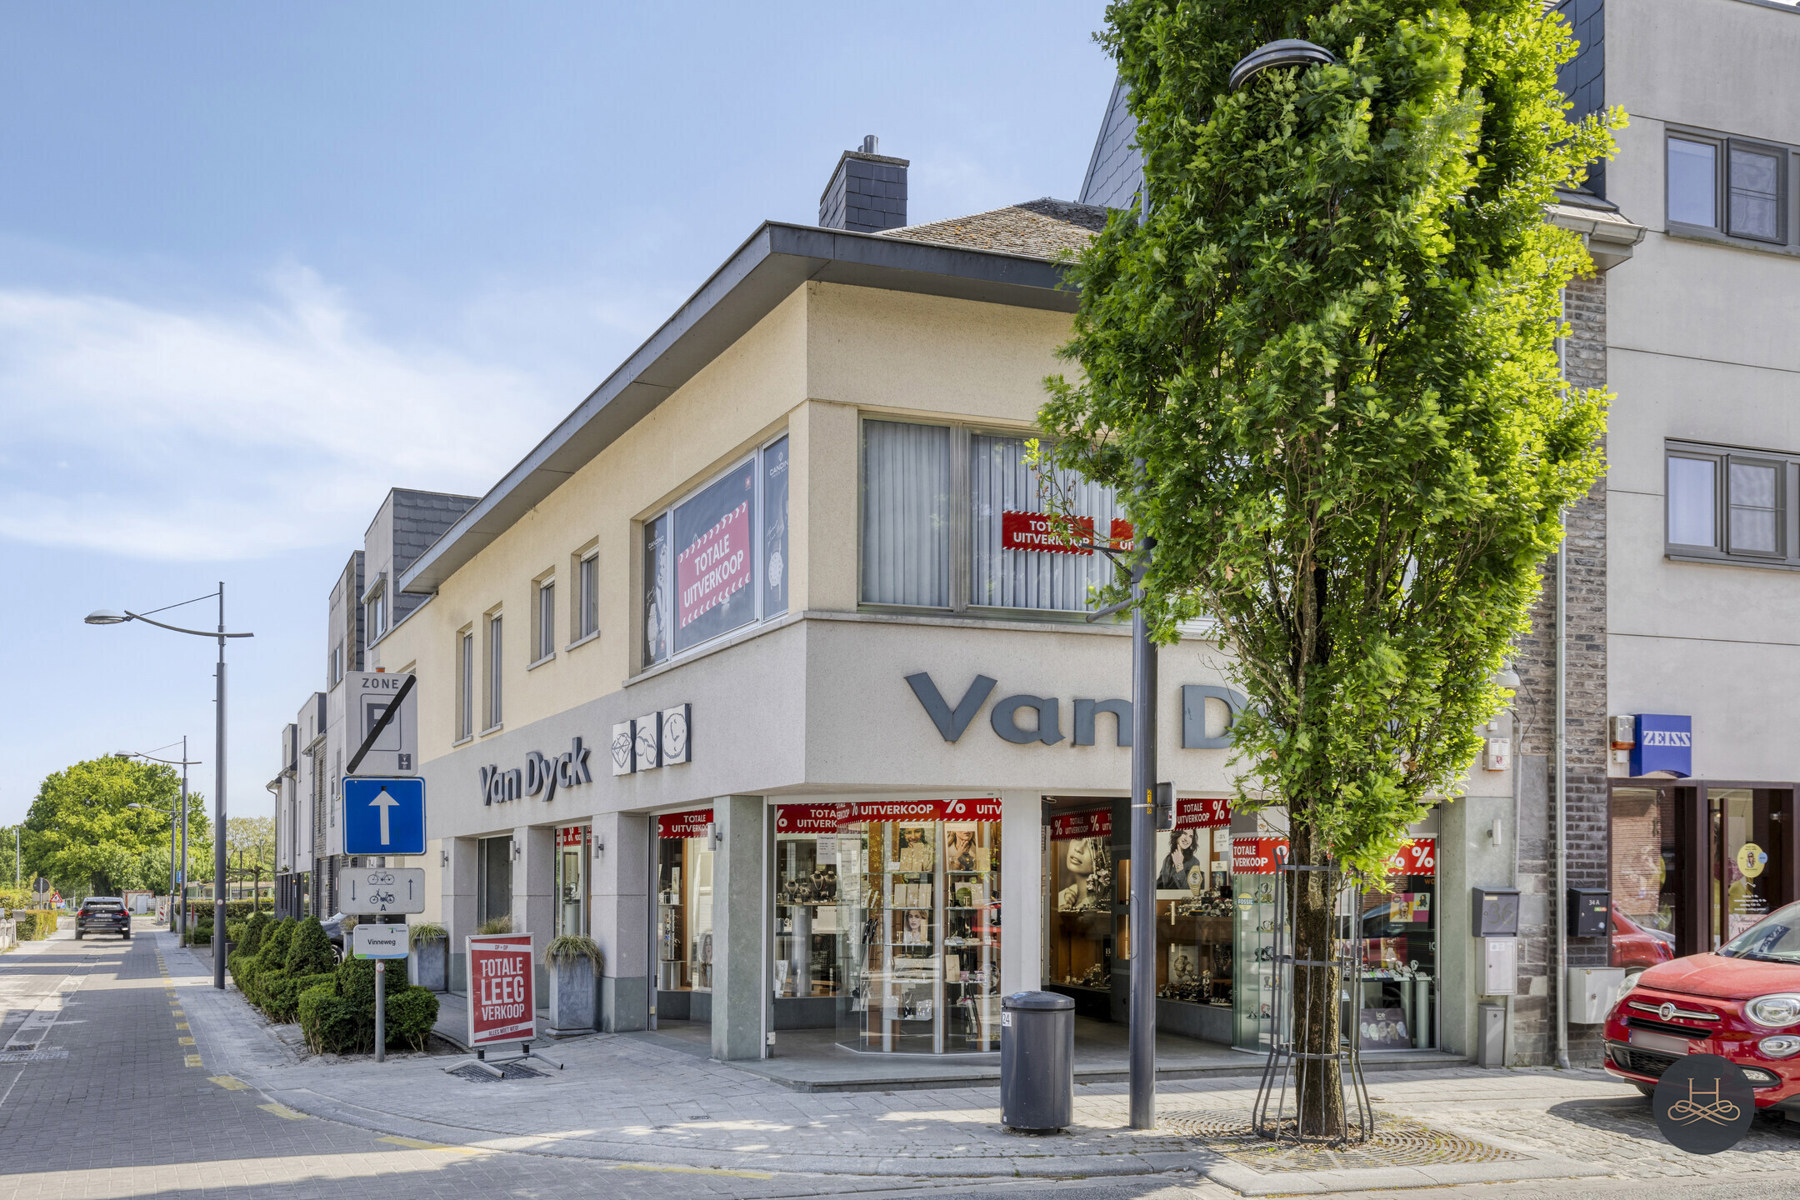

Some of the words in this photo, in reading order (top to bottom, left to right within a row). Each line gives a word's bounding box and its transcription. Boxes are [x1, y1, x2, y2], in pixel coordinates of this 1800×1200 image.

[1029, 520, 1074, 534] TOTE
[694, 533, 730, 576] TOTALE
[683, 549, 744, 608] UITVERKOOP
[361, 678, 399, 689] ZONE
[903, 671, 1133, 747] Van
[366, 703, 394, 737] P
[1643, 730, 1691, 747] ZEISS
[479, 764, 522, 806] Van
[525, 736, 592, 802] Dyck
[860, 803, 934, 816] UITVERKOOP
[1183, 802, 1203, 813] TOTALE
[683, 814, 706, 824] TOTALE
[1177, 812, 1210, 824] UITVERKOOP
[1233, 845, 1257, 856] TOTALE
[380, 904, 387, 912] A
[367, 938, 396, 947] Vinneweg
[480, 957, 524, 977] TOTALE
[481, 976, 525, 1006] LEEG
[481, 1003, 525, 1022] VERKOOP
